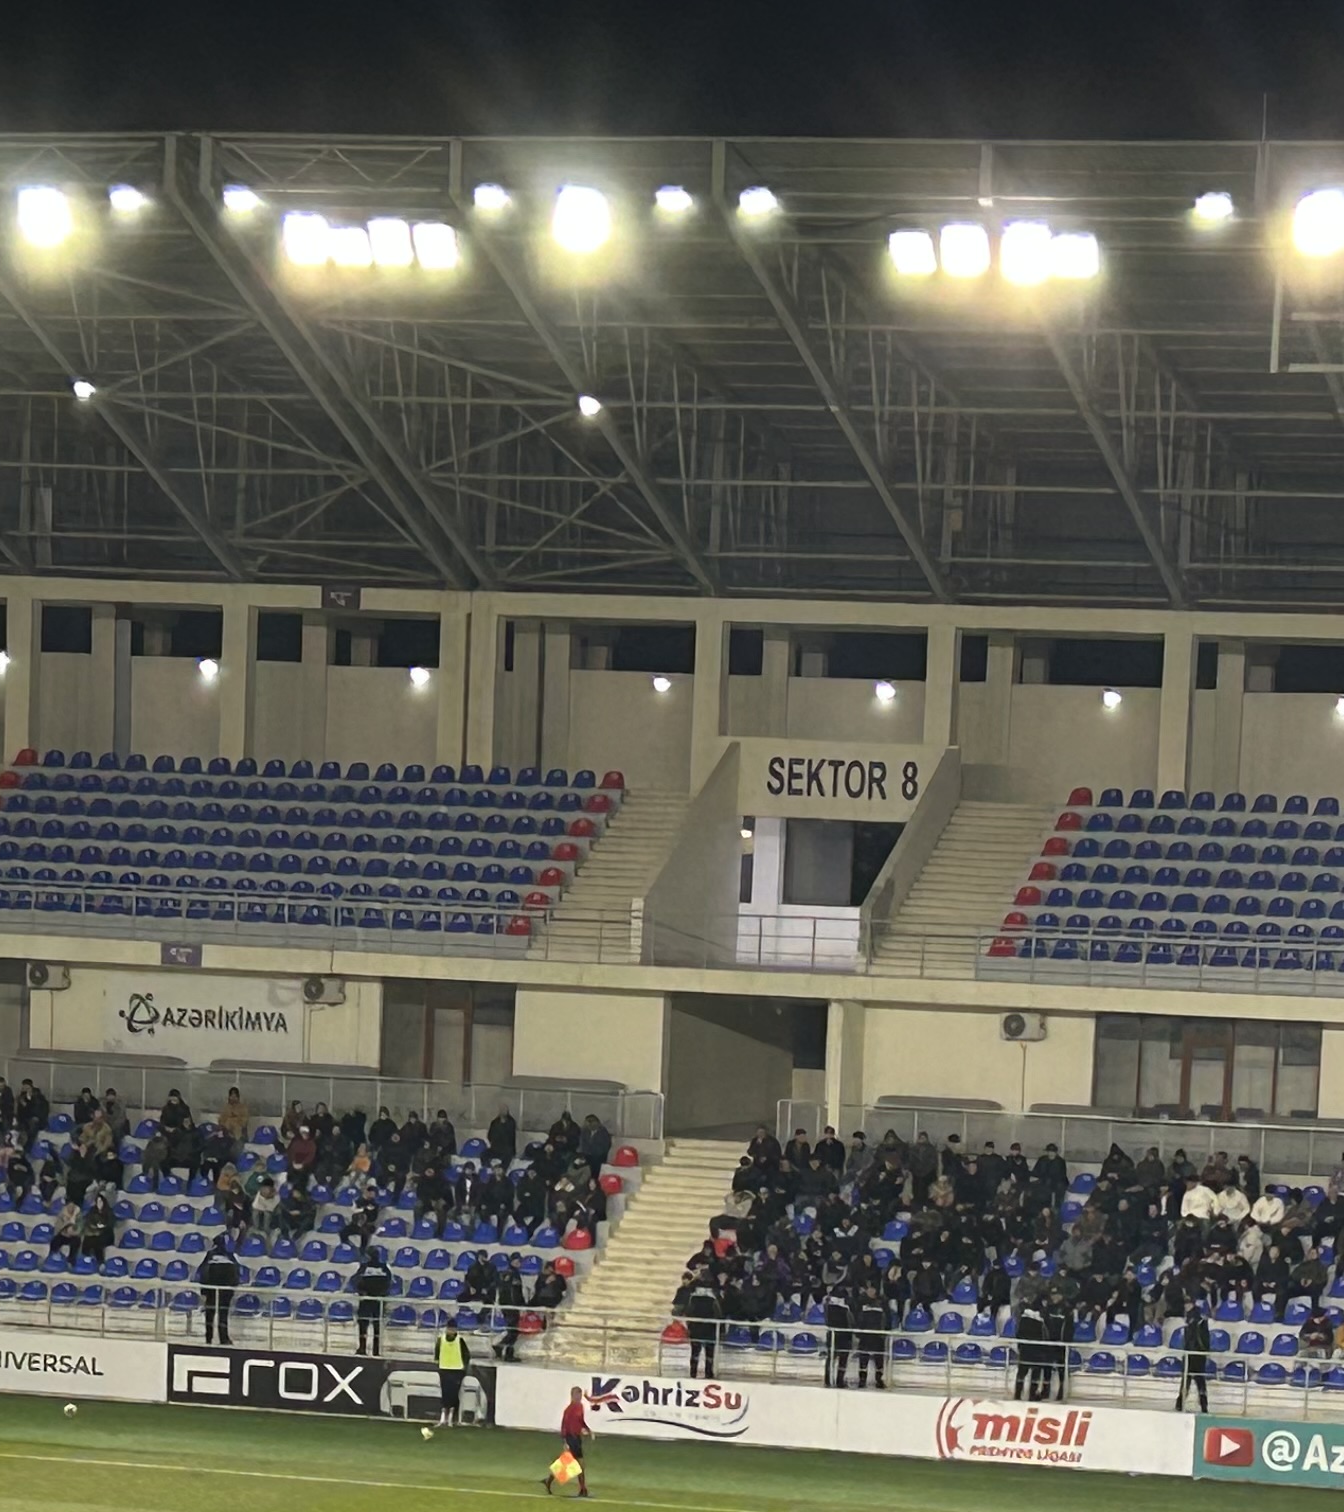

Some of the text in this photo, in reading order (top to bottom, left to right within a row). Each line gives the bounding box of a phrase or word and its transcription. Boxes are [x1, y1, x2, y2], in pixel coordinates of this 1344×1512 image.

[767, 756, 918, 800] SEKTOR 8
[972, 1407, 1093, 1446] misli
